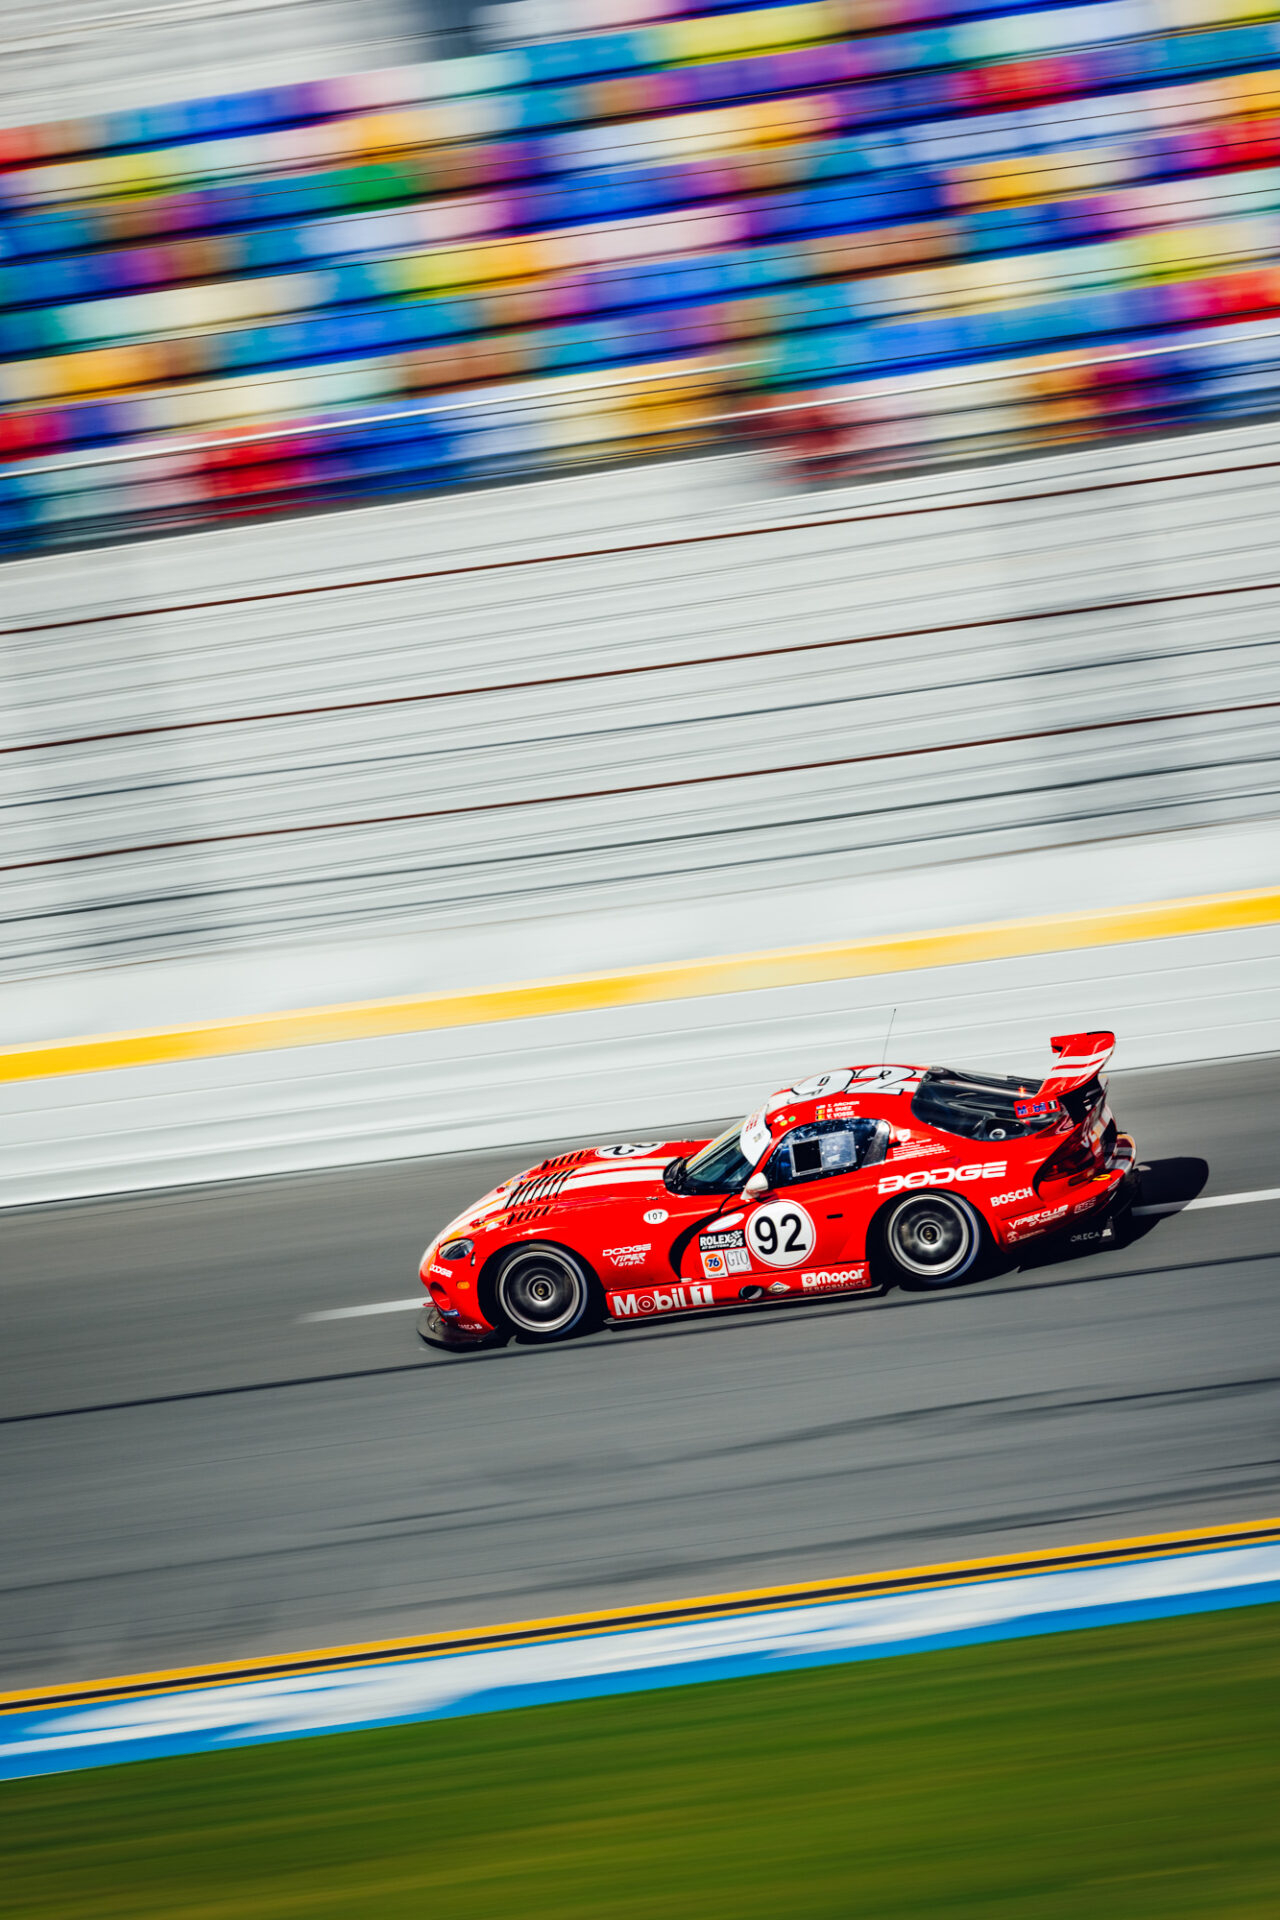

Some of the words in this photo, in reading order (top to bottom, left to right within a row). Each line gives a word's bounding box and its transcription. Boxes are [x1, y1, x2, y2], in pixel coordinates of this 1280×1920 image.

[876, 1160, 1008, 1195] DODGE
[990, 1186, 1034, 1207] BOSCH
[647, 1211, 663, 1221] 107
[1008, 1213, 1040, 1230] VIPER
[1040, 1204, 1069, 1219] CLUB
[700, 1233, 731, 1247] ROLEX
[730, 1237, 744, 1248] 24
[754, 1213, 807, 1255] 92
[1070, 1230, 1100, 1242] ORECA
[602, 1243, 652, 1256] DODGE
[610, 1252, 647, 1266] VIPER
[707, 1256, 721, 1268] 76
[726, 1250, 749, 1267] GTO
[428, 1263, 454, 1278] DODGE
[817, 1268, 865, 1285] Mopar
[612, 1287, 688, 1316] Mobil
